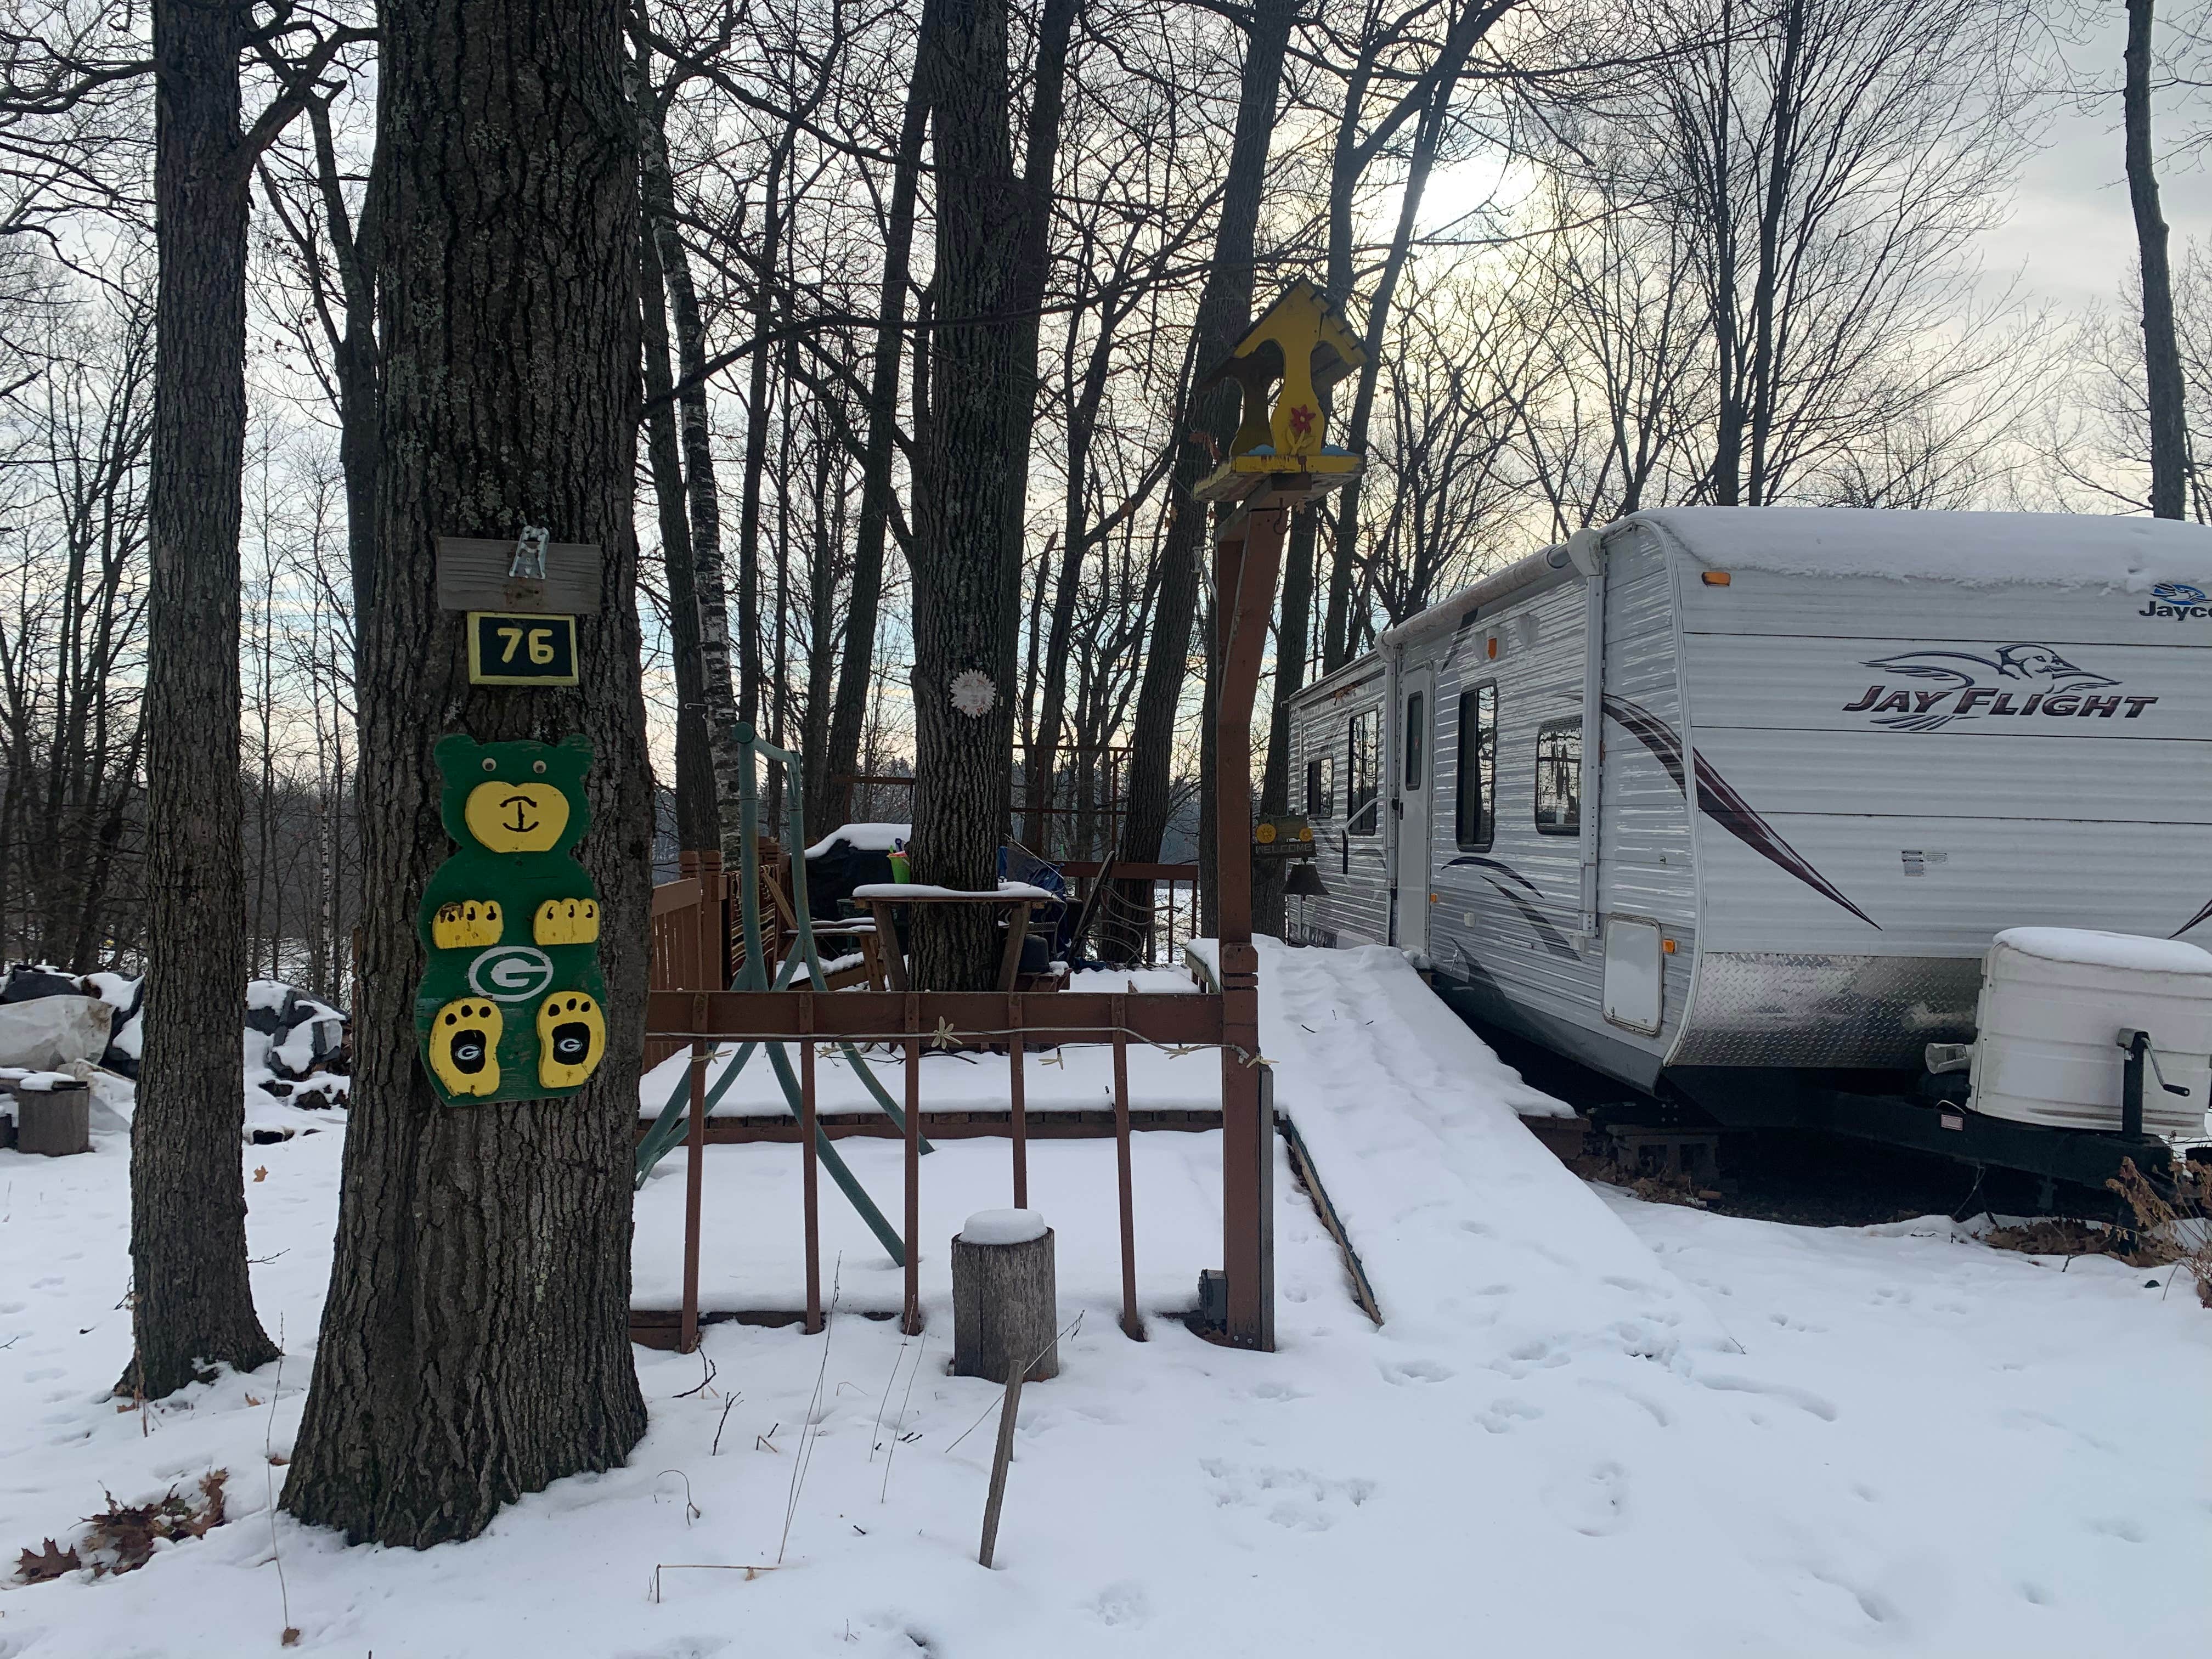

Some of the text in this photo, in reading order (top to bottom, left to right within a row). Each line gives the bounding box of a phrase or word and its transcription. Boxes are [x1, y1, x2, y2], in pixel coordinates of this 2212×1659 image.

[2138, 601, 2212, 622] Jayc
[497, 627, 555, 664] 76
[1842, 685, 2159, 718] JAY FLIGHT
[1255, 844, 1313, 854] WELCOME
[474, 950, 550, 997] G
[456, 1045, 481, 1060] G
[559, 1038, 582, 1053] G
